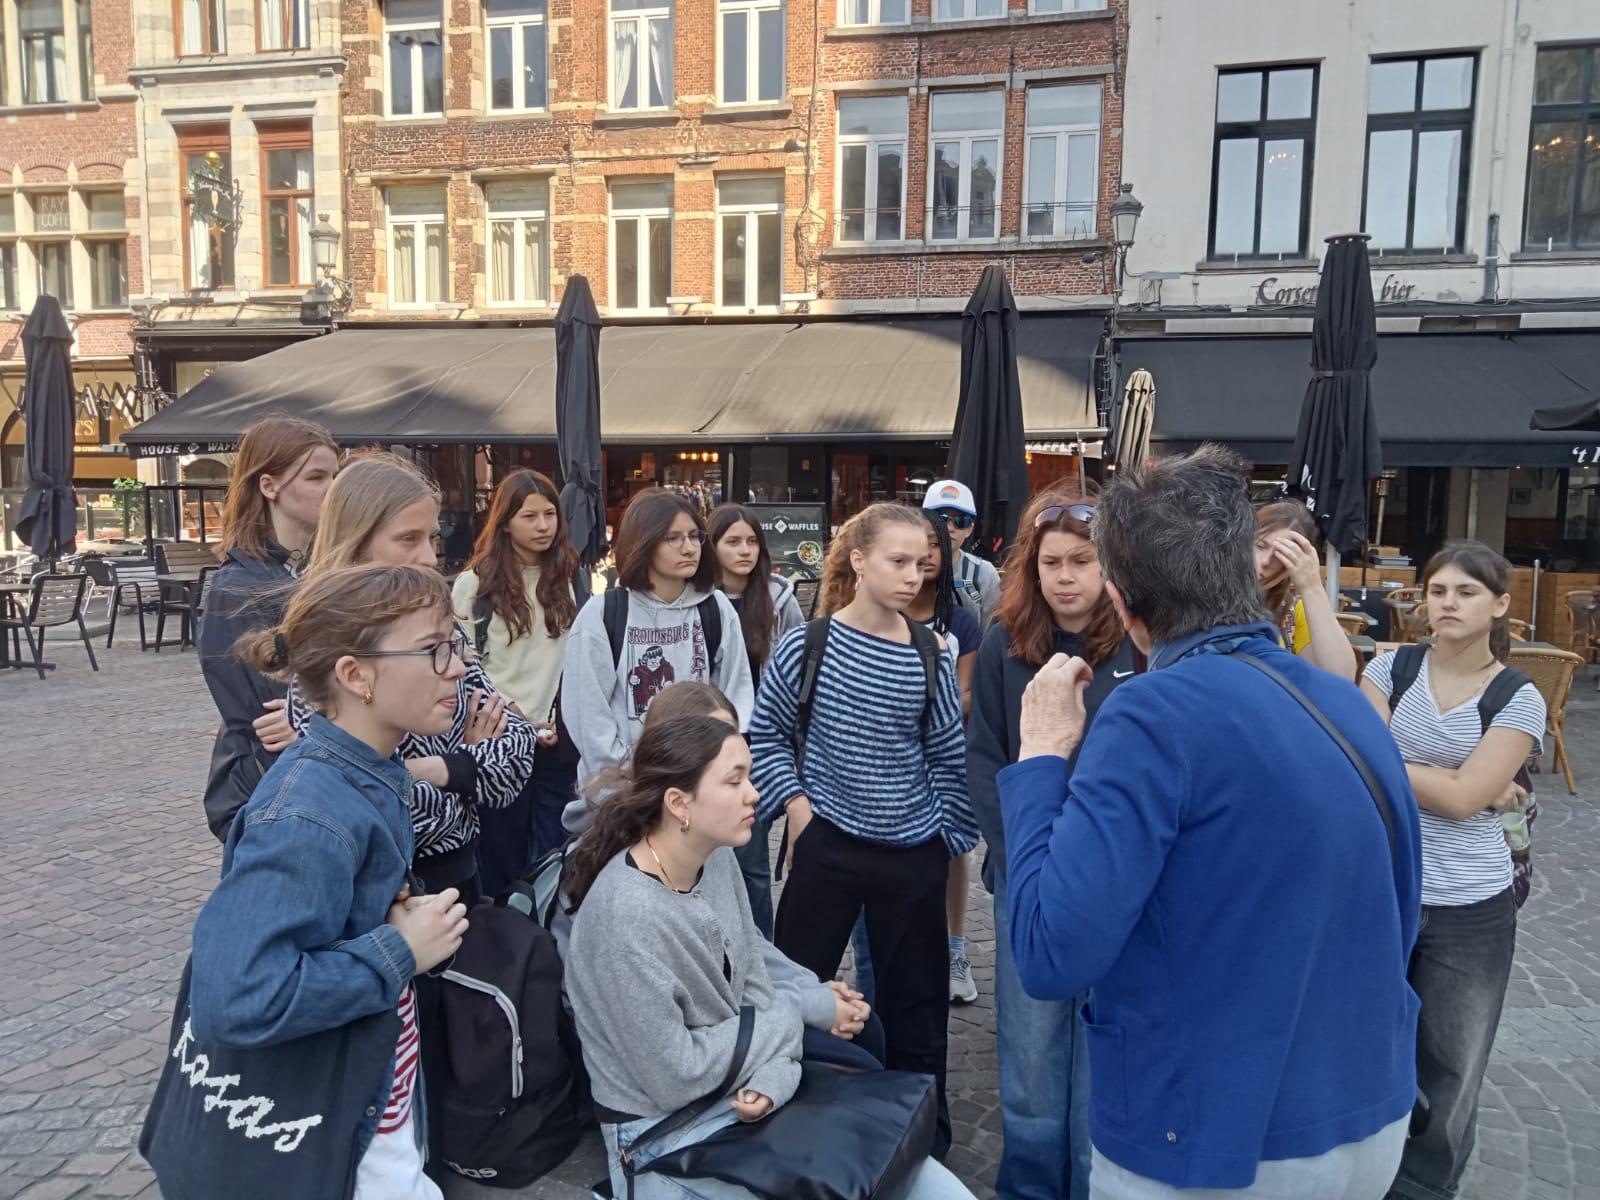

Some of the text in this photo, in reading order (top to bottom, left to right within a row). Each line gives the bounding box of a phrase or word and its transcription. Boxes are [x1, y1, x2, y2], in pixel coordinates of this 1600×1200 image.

[1381, 273, 1416, 300] bier
[140, 444, 180, 455] HOUSE
[788, 523, 819, 531] WAFFLES
